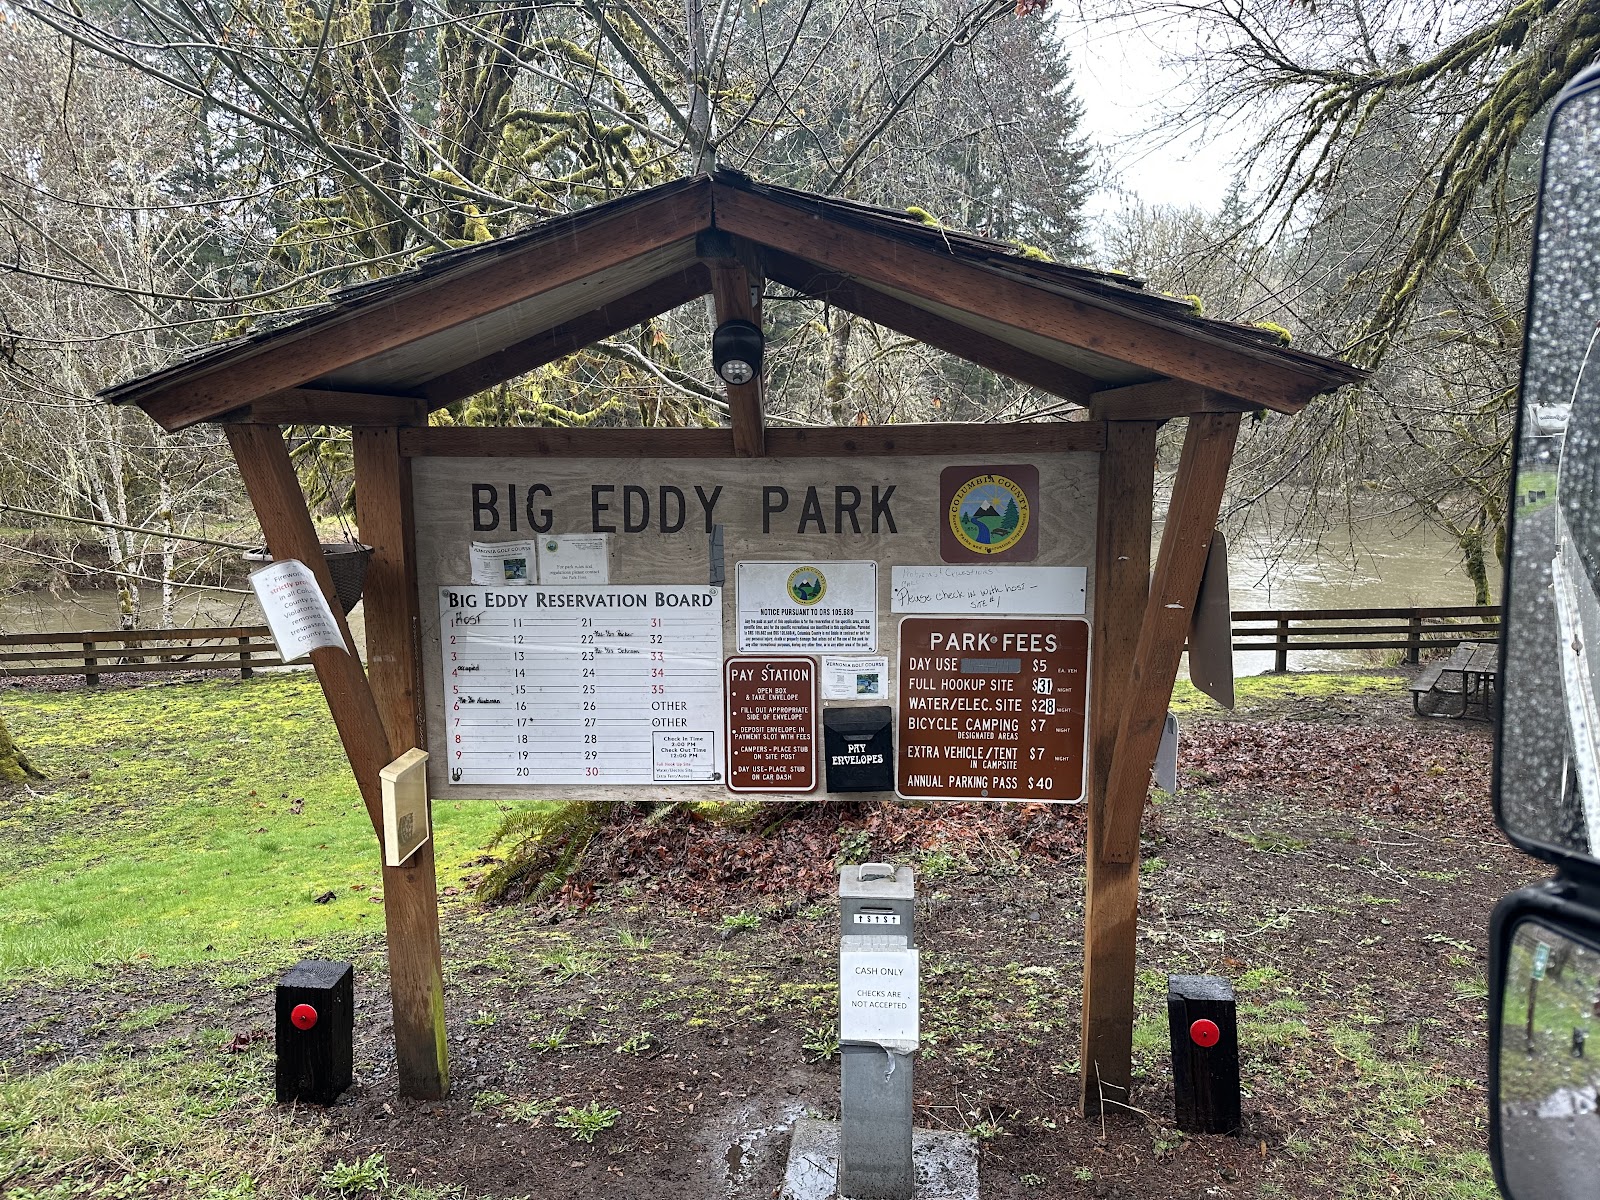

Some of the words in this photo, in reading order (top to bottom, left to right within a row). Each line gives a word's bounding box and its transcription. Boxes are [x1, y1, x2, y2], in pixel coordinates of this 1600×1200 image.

[952, 477, 995, 513] COLUMBIA
[998, 479, 1028, 512] COUNTY
[472, 484, 553, 534] BIG
[591, 484, 723, 534] EDDY
[763, 485, 898, 534] PARK
[270, 582, 294, 595] strictly
[936, 590, 965, 600] check
[284, 597, 309, 609] County
[449, 593, 477, 608] BIG
[485, 593, 528, 608] EDDY
[536, 592, 647, 608] RESERVATION
[655, 592, 713, 607] BOARD
[284, 606, 314, 619] Violators
[292, 614, 321, 626] removed
[456, 611, 485, 625] HOST
[582, 618, 592, 627] 21
[651, 618, 662, 627] 31
[513, 618, 522, 628] 11
[291, 622, 325, 636] trespassed
[298, 631, 321, 642] County
[450, 635, 456, 644] 2
[513, 635, 524, 644] 12
[581, 635, 594, 644] 22
[650, 635, 662, 644] 32
[930, 632, 991, 651] PARK
[1003, 633, 1058, 653] FEES
[451, 652, 457, 661] 3
[514, 652, 525, 661] 13
[582, 652, 594, 661] 23
[651, 652, 664, 661] 33
[909, 658, 932, 671] DAY
[936, 658, 958, 671] USE
[1032, 659, 1047, 672] $5
[452, 669, 458, 678] 4
[515, 668, 525, 678] 14
[583, 668, 595, 678] 24
[651, 668, 664, 678] 34
[732, 669, 754, 681] PAY
[761, 669, 809, 681] STATION
[453, 685, 459, 694] 5
[515, 685, 526, 694] 15
[583, 685, 596, 694] 25
[651, 685, 664, 694] 35
[909, 678, 936, 690] FULL
[942, 679, 986, 691] HOOKUP
[990, 679, 1014, 691] SITE
[1032, 678, 1052, 695] $31
[454, 702, 460, 711] 6
[516, 702, 527, 711] 16
[583, 702, 596, 711] 26
[651, 701, 688, 711] OTHER
[909, 698, 992, 711] WATER/ELEC.
[995, 699, 1022, 712] SITE
[1031, 698, 1055, 715] $28
[455, 718, 460, 727] 7
[517, 718, 527, 727] 17
[584, 718, 596, 727] 27
[652, 718, 688, 727] OTHER
[908, 718, 958, 731] BICYCLE
[966, 718, 1019, 732] CAMPING
[1031, 719, 1046, 733] $7
[455, 735, 461, 744] 8
[518, 735, 528, 744] 18
[584, 735, 597, 744] 28
[958, 732, 994, 740] DESIGNATED
[998, 732, 1019, 740] AREAS
[848, 744, 866, 753] PAY
[456, 751, 462, 760] 9
[518, 751, 528, 760] 19
[584, 751, 598, 760] 29
[908, 746, 939, 758] EXTRA
[1029, 748, 1045, 761] $7
[832, 754, 883, 765] ENVELOPES
[970, 761, 977, 769] IN
[983, 761, 1017, 770] CAMPSITE
[516, 768, 529, 776] 20
[586, 767, 599, 776] 30
[908, 775, 943, 788] ANNUAL
[949, 776, 988, 789] PARKING
[993, 776, 1017, 789] PASS
[1028, 777, 1052, 790] $40
[855, 967, 878, 976] CASH
[881, 967, 904, 976] ONLY
[857, 990, 886, 998] CHECKS
[870, 1001, 907, 1009] ACCEPTED
